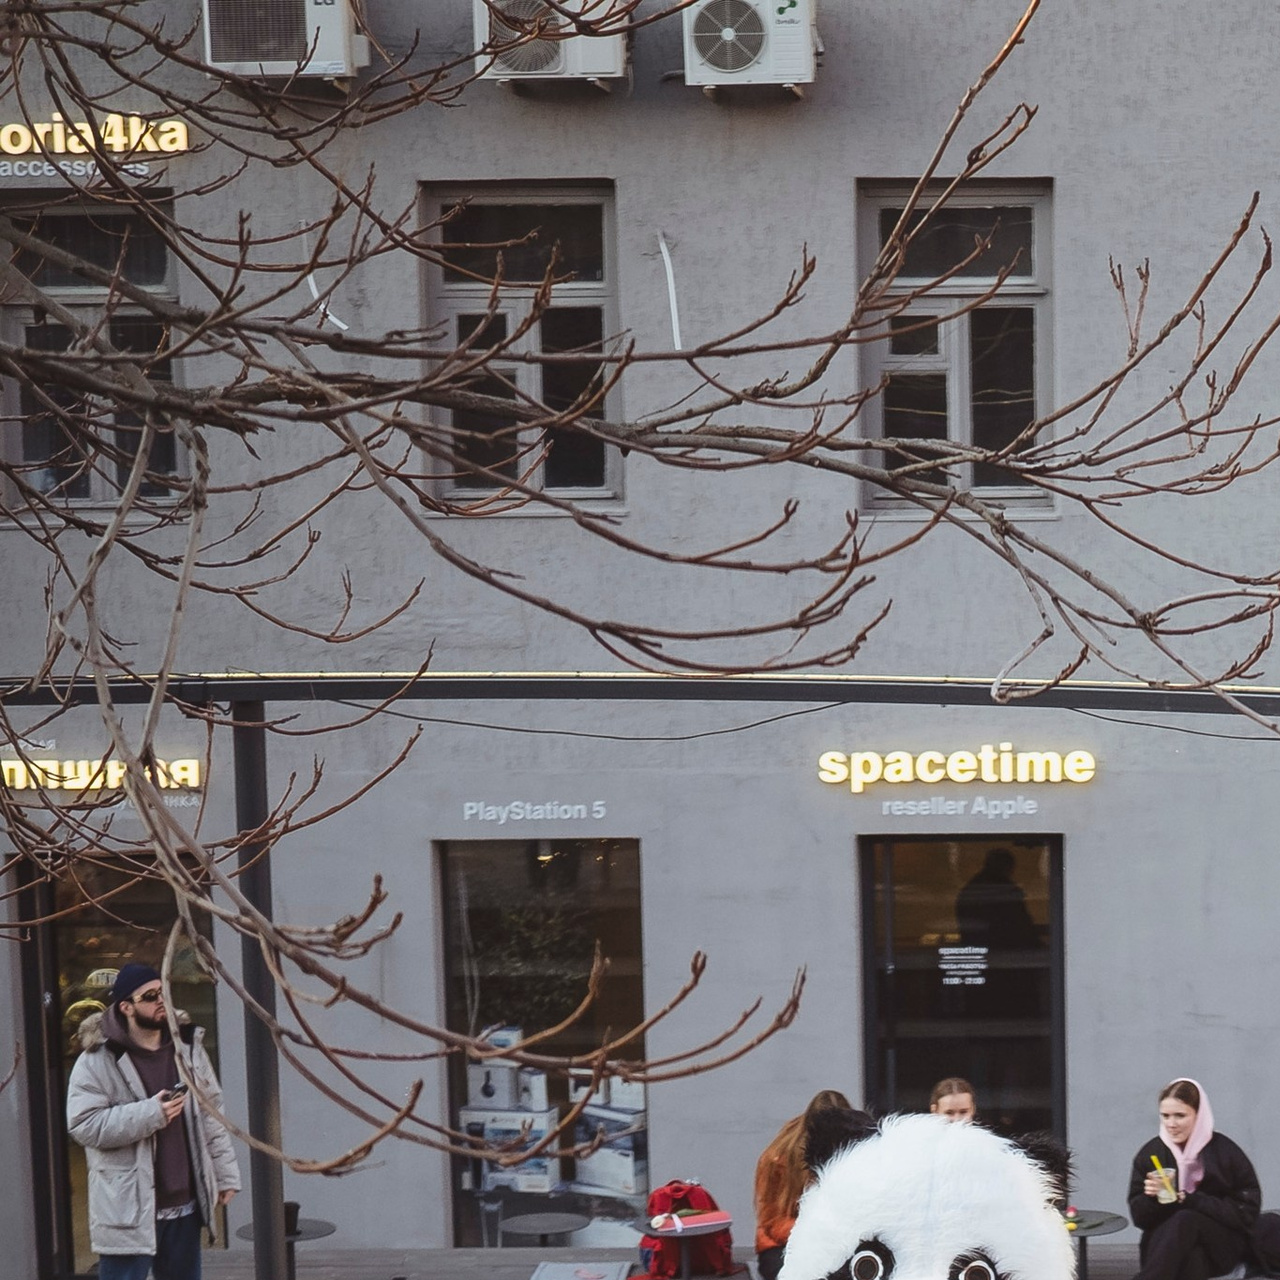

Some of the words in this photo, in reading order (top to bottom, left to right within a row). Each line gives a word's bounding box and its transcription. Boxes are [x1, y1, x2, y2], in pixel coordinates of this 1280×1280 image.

[0, 156, 149, 177] accessoes
[818, 742, 1096, 793] spacetime
[463, 801, 587, 825] PlayStation
[592, 800, 606, 819] 5
[882, 799, 967, 816] reseller
[970, 796, 1038, 819] Apple
